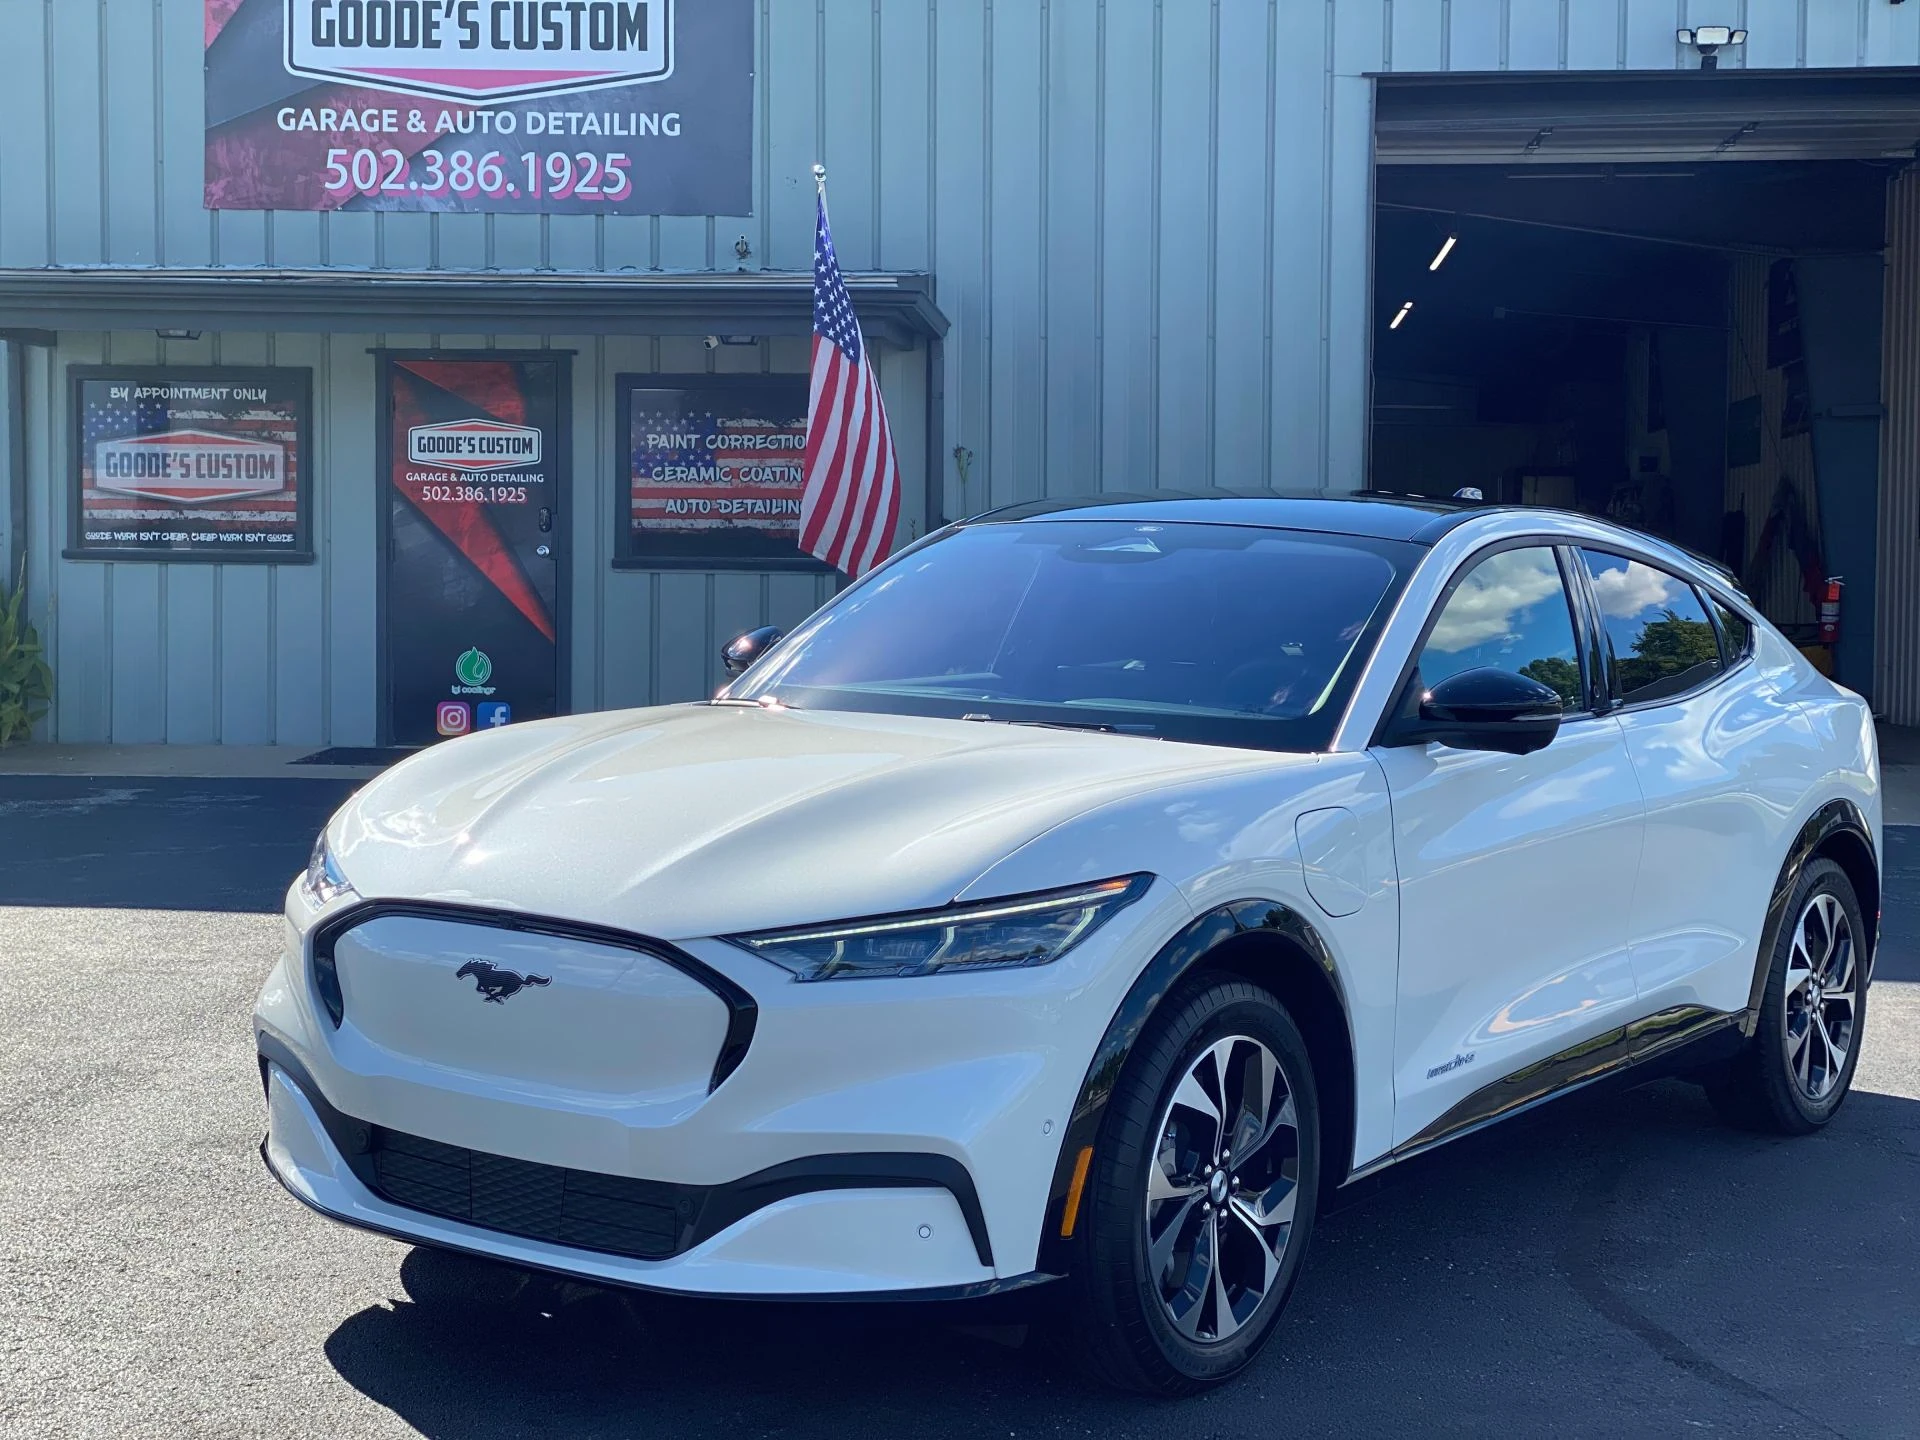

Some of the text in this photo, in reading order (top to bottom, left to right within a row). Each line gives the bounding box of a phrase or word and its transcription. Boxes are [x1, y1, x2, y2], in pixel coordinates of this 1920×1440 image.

[311, 0, 649, 51] GOODE'S CUSTOM
[276, 107, 682, 137] GARAGE & AUTO DETAILING
[324, 149, 628, 194] 502.386.1925
[110, 387, 267, 403] BY APPOINTMENT ONLY
[417, 436, 533, 454] GOODE'S CUSTOM
[646, 434, 807, 450] PAINT CORRECTIO
[105, 452, 275, 480] GOODE'S CUSTOM
[652, 466, 804, 482] CERAMIC COATIN
[406, 472, 544, 483] GARAGE & AUTO DETAILING
[422, 486, 527, 502] 502.386.1925
[665, 499, 802, 515] AUTO DETAILIN
[191, 532, 218, 542] CHEAP
